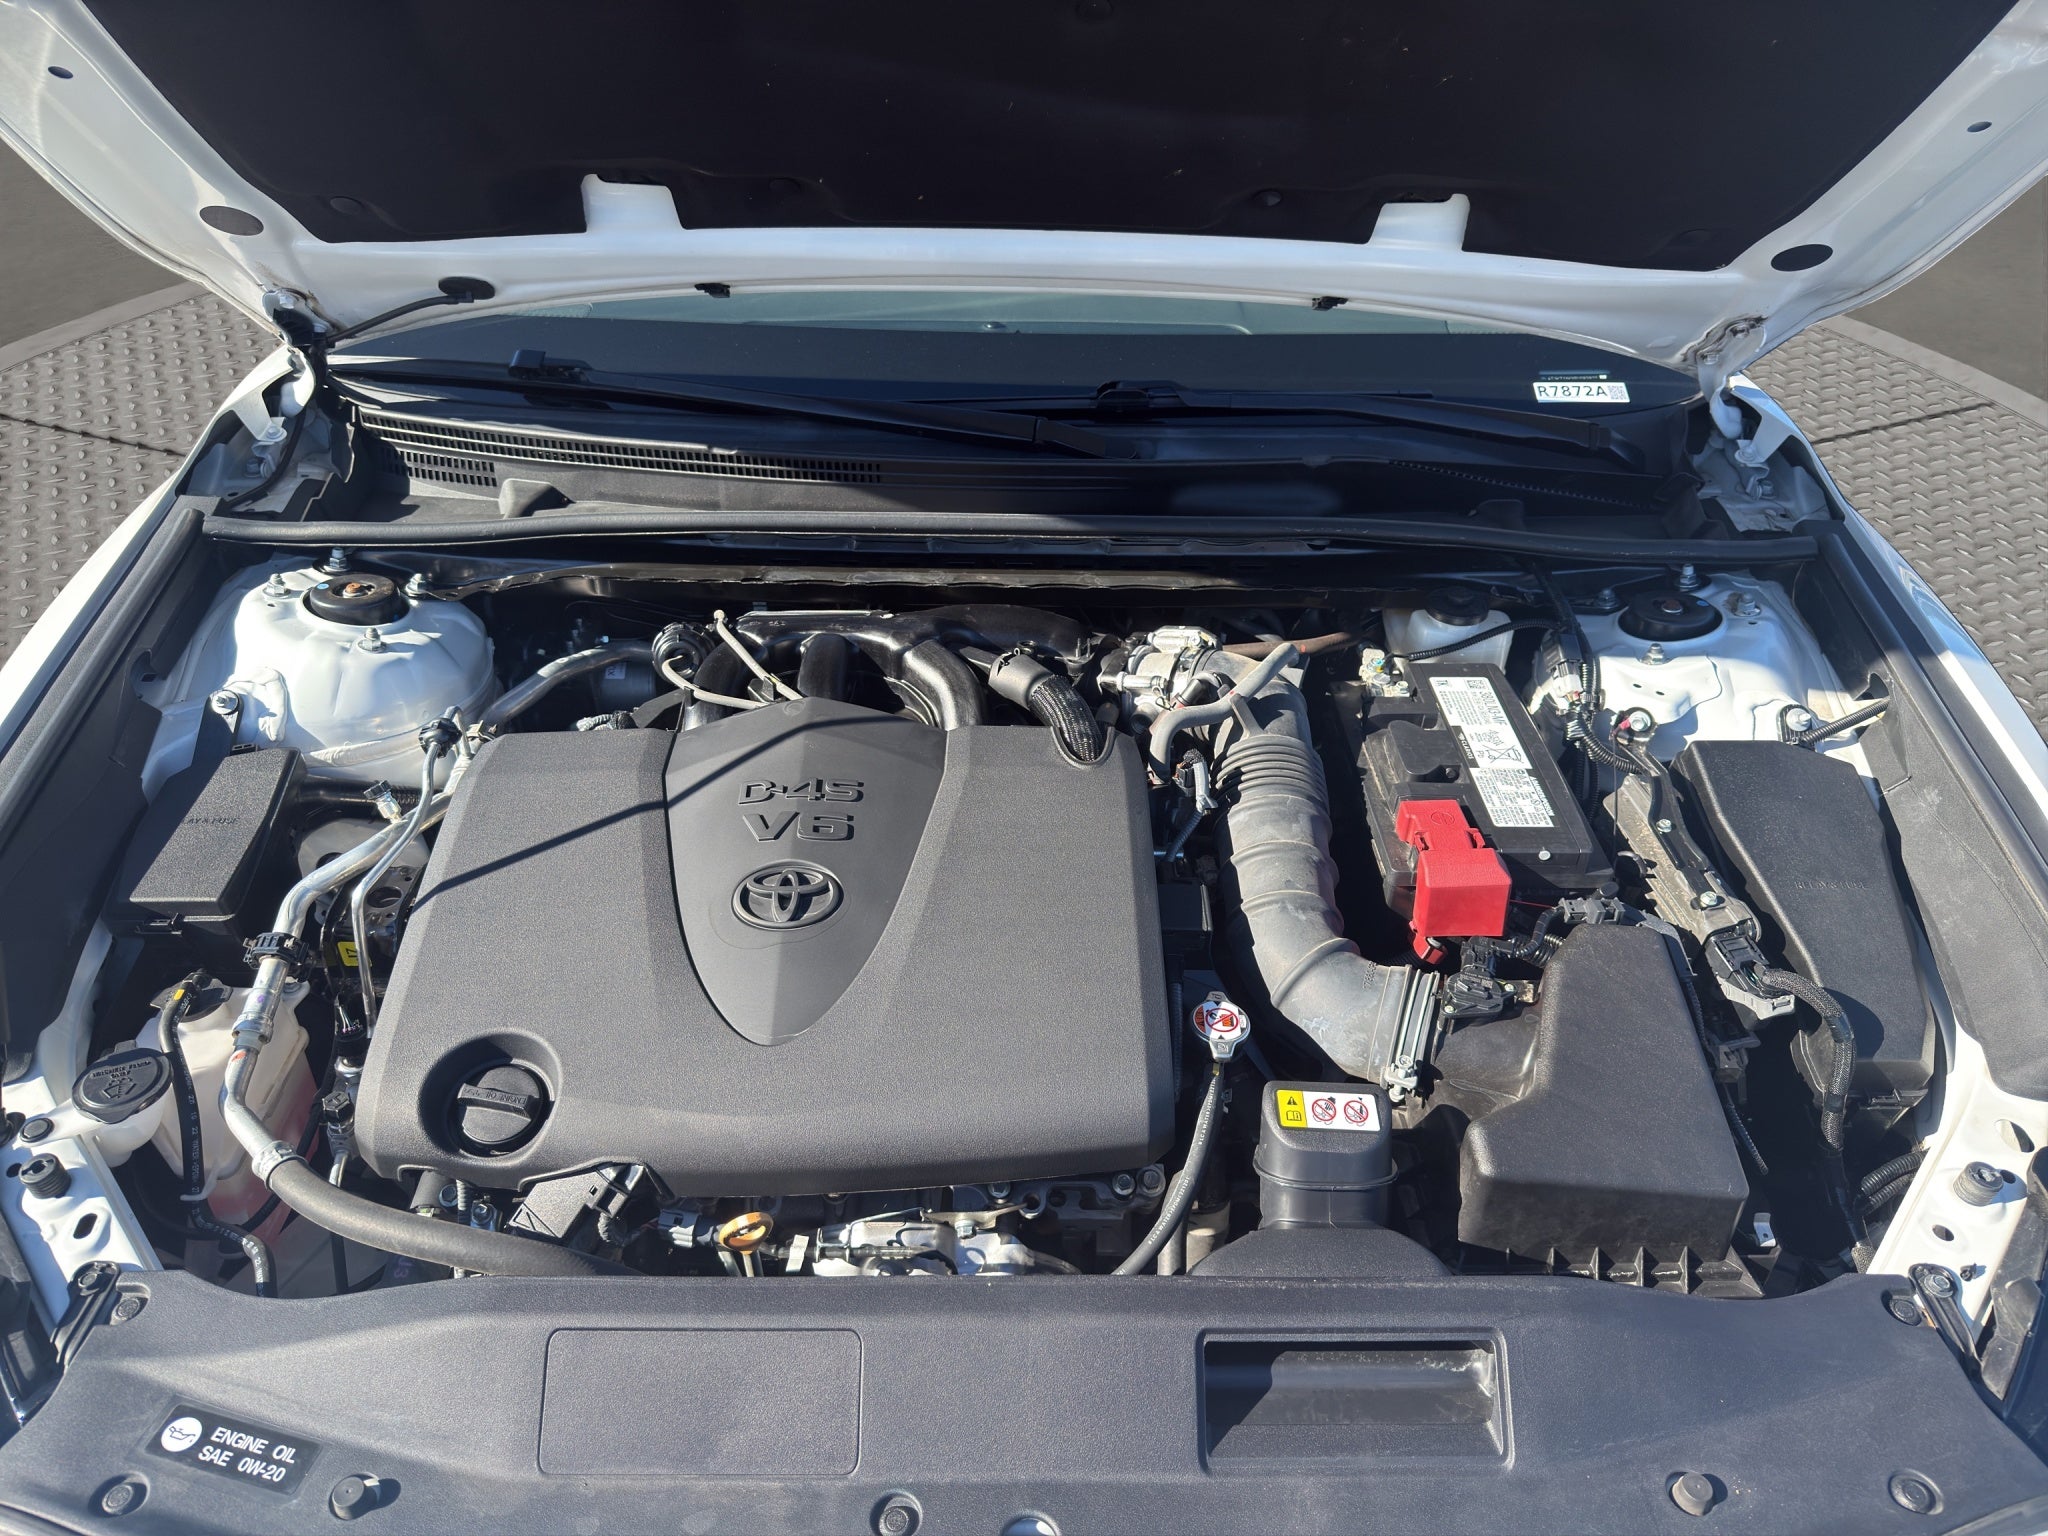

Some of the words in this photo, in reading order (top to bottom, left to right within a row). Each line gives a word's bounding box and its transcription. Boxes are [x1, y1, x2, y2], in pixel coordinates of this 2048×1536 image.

[1537, 385, 1608, 397] R7872A
[1461, 739, 1475, 760] CLARIOS
[738, 778, 865, 804] D-4S
[742, 811, 855, 842] V6
[210, 1427, 268, 1455] ENGINE
[272, 1444, 297, 1464] OIL
[198, 1445, 234, 1467] SAE
[237, 1456, 287, 1482] 0W-20
